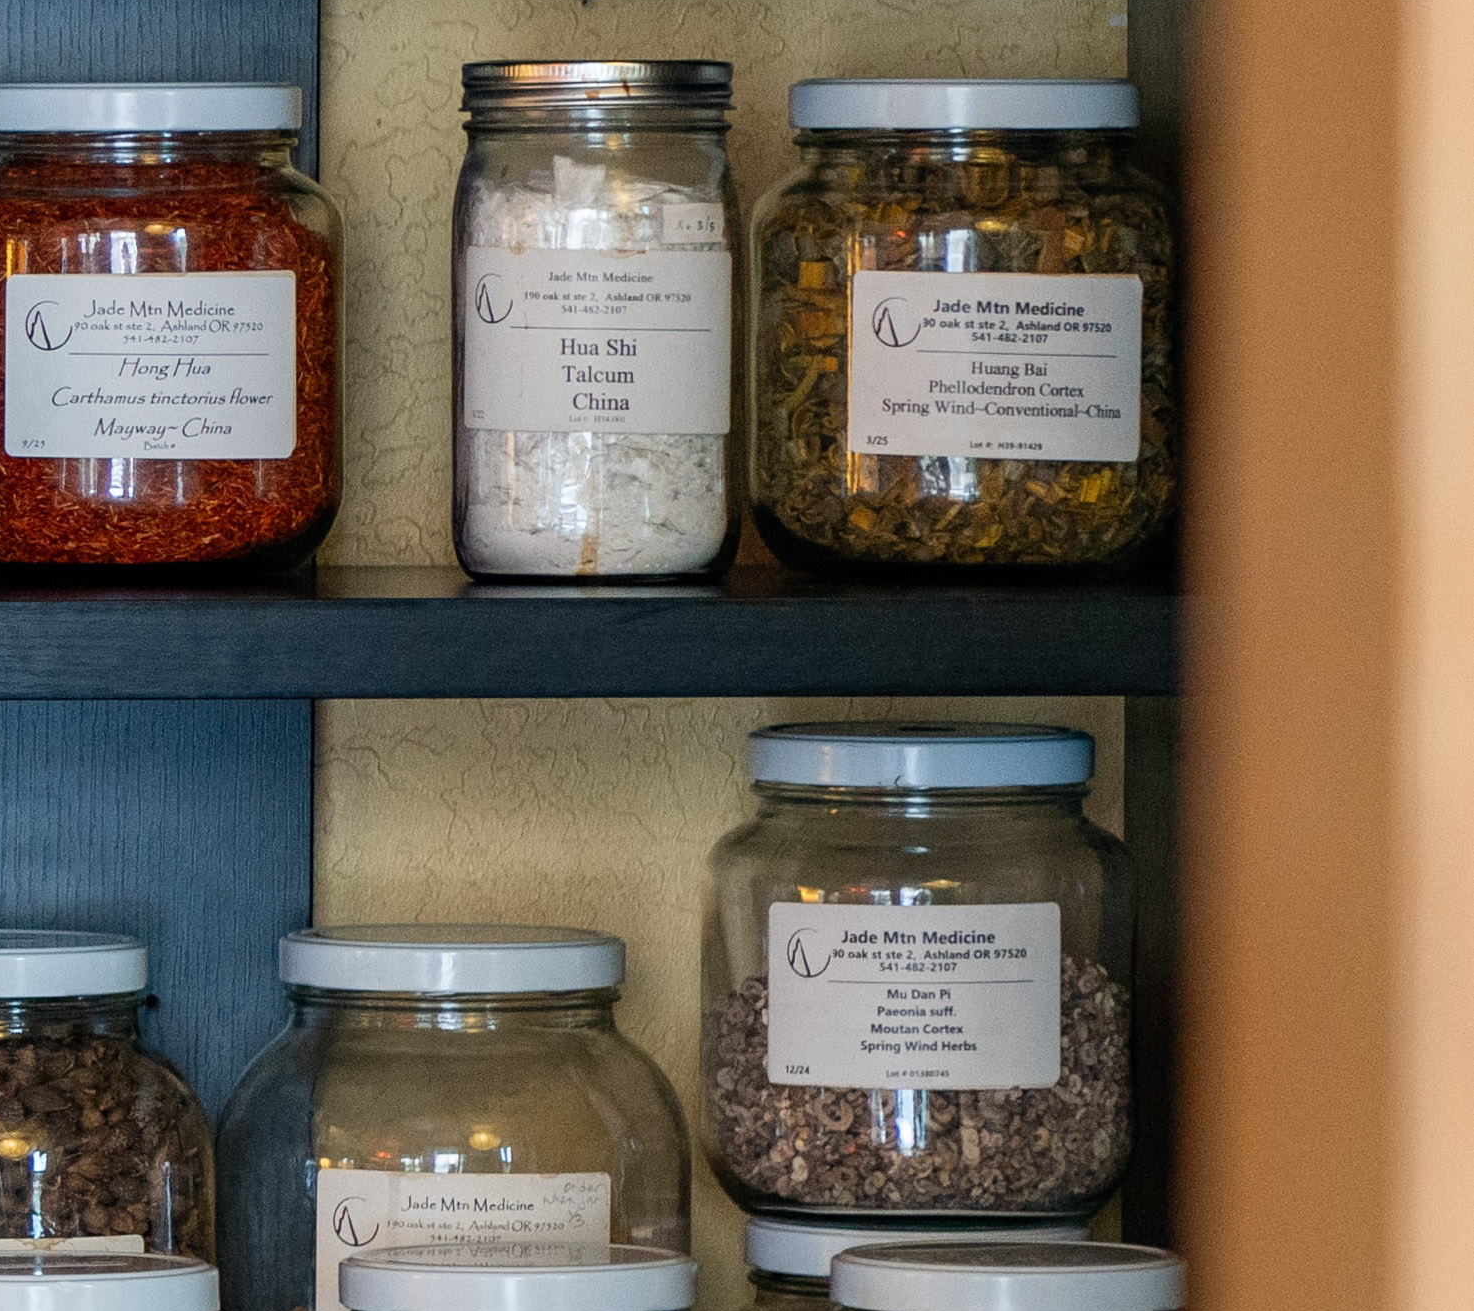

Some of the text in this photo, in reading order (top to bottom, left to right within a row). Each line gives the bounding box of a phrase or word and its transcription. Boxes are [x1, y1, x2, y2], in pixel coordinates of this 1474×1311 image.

[561, 339, 636, 356] Hua Shi
[119, 356, 212, 380] Hong Hua
[562, 366, 634, 383] Talcum
[972, 362, 1047, 379] Huang Bai
[573, 393, 630, 411] China
[887, 989, 951, 999] Mu Dan Pi
[871, 1024, 963, 1034] Moutan Cortex
[401, 1196, 534, 1212] Jade Mtn Medicine
